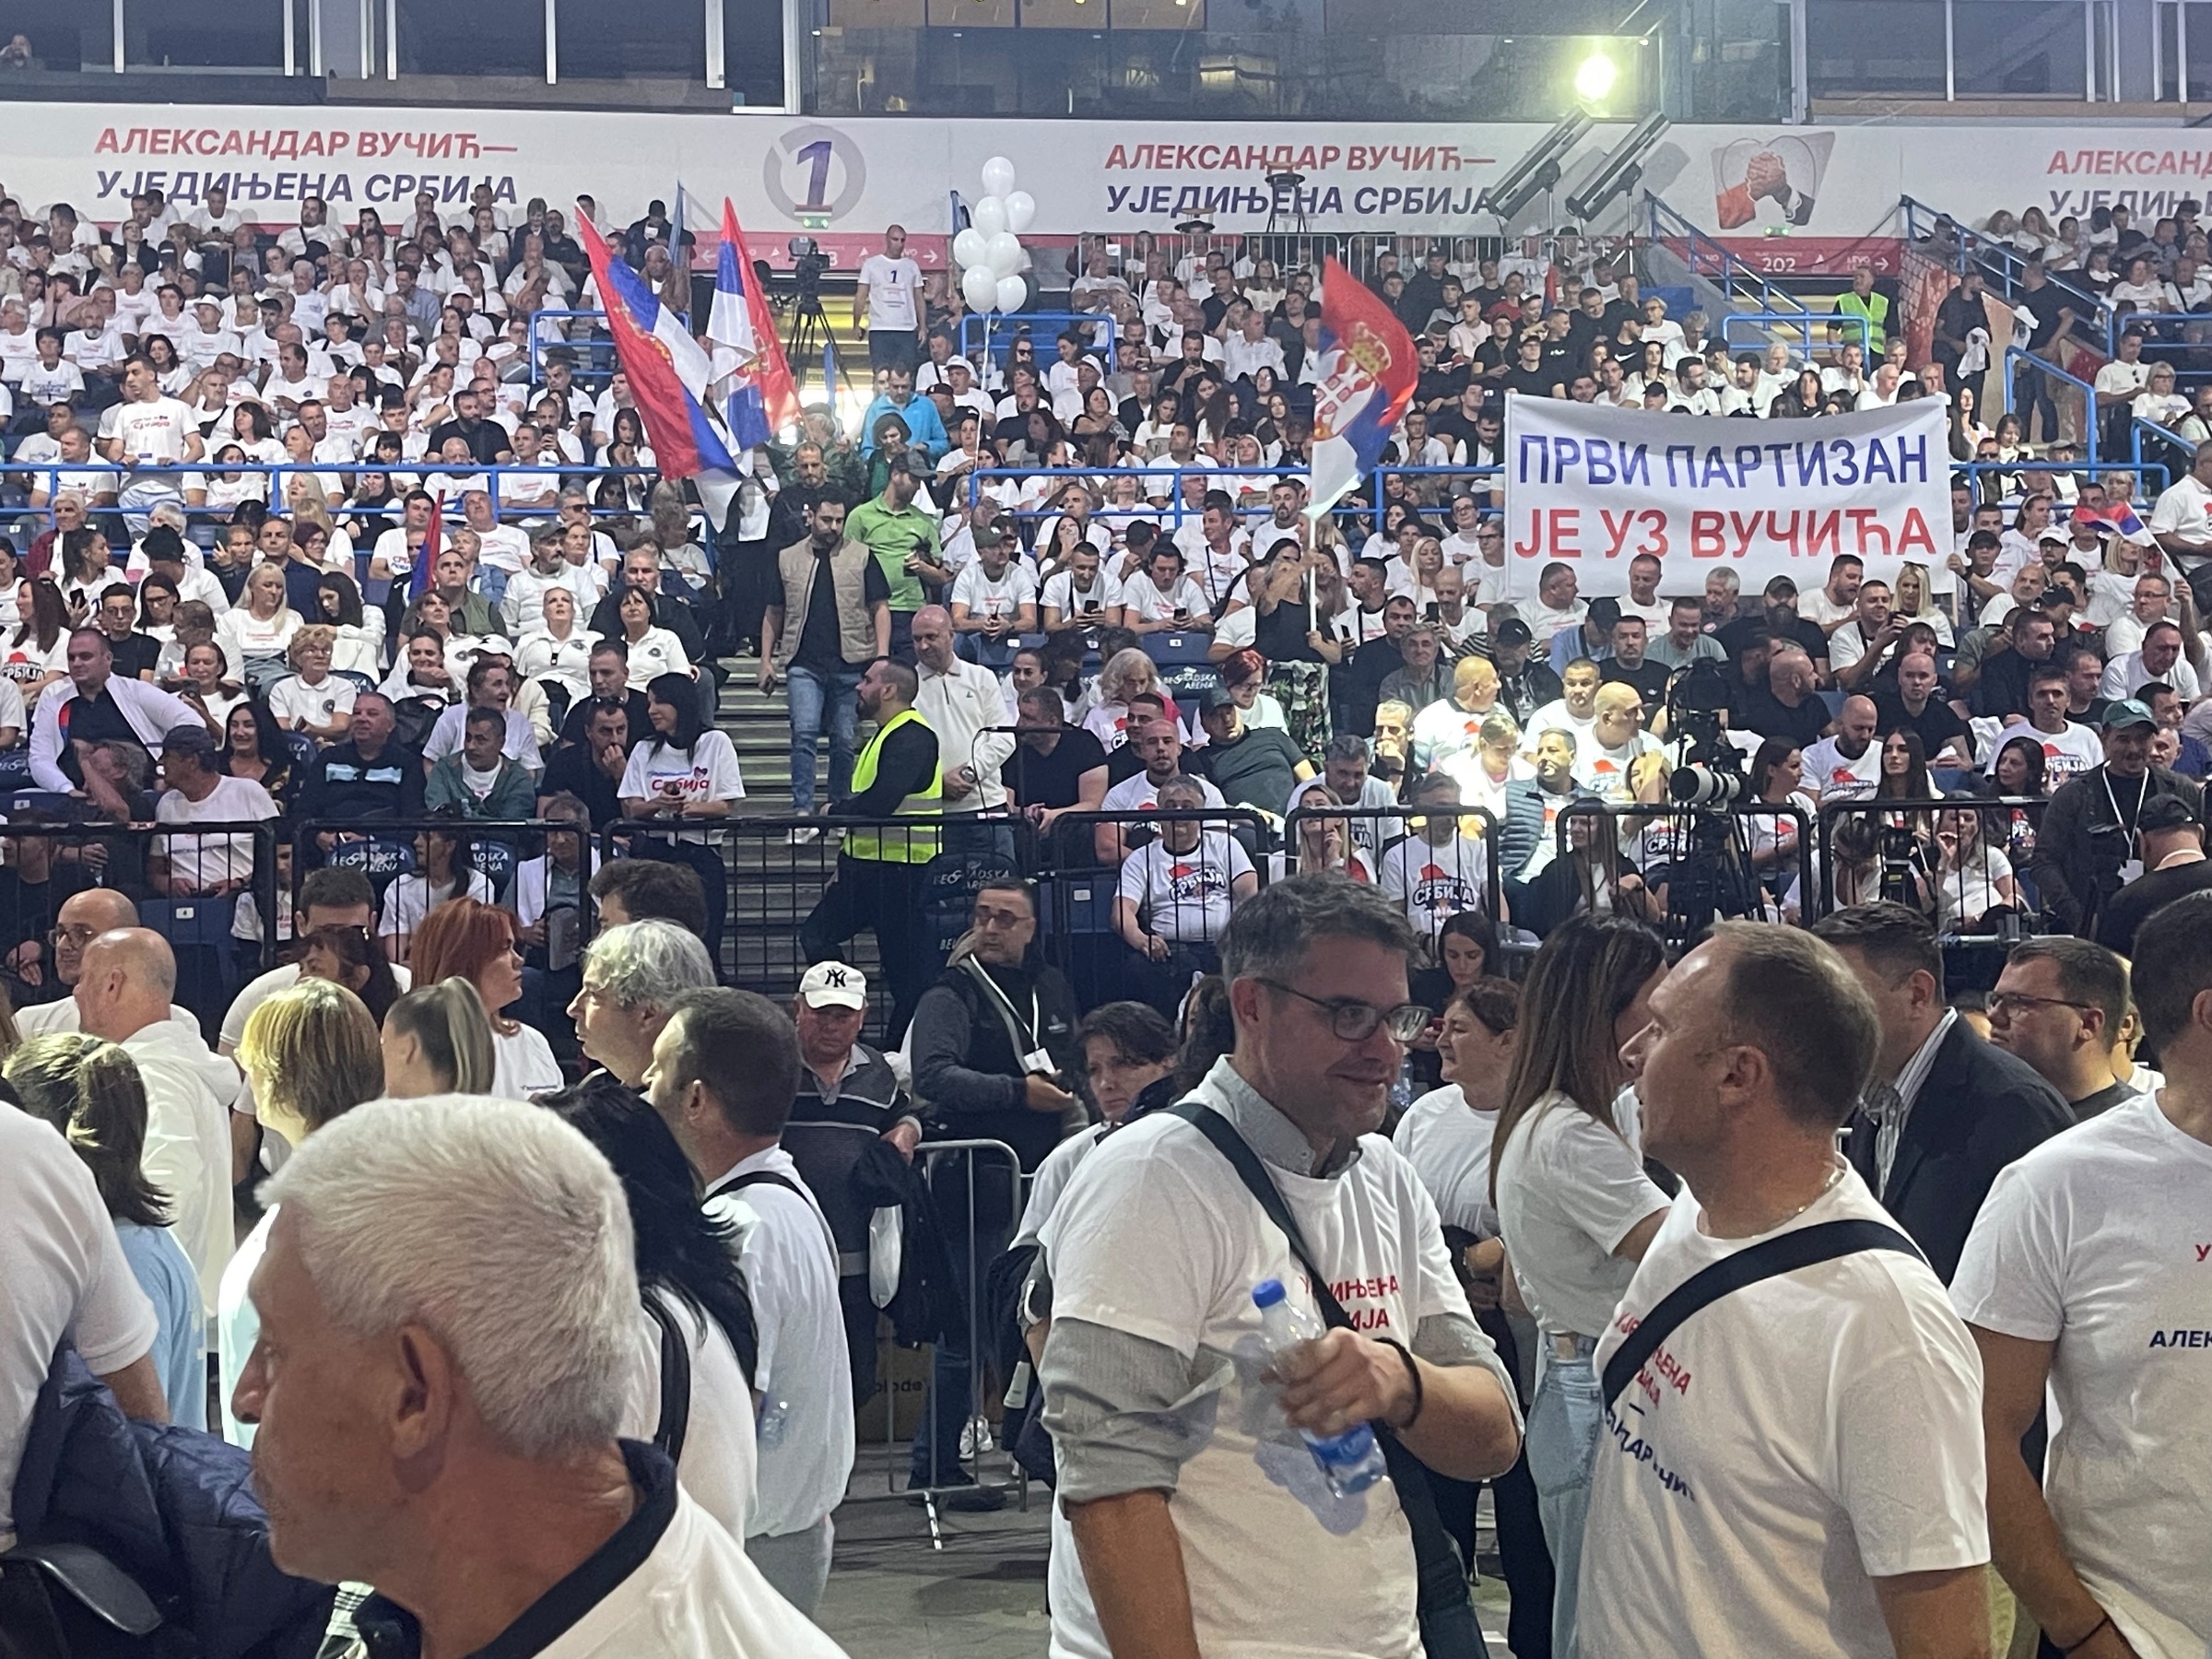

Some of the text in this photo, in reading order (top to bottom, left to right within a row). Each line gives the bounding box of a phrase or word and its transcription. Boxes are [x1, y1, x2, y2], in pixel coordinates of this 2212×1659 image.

[95, 128, 349, 161] АЛЕКСАНДАР
[1105, 144, 1341, 175] АЛЕКСАНДАР
[1107, 185, 1495, 218] УЈЕДИЊЕНА СРБИЈА
[881, 270, 888, 284] 1
[1761, 256, 1795, 273] 202
[1519, 434, 1928, 488] ПРВИ ПАРТИЗАН
[1514, 506, 1936, 559] ЈЕ УЗ ВУЧИЋА
[652, 778, 710, 793] Сбија
